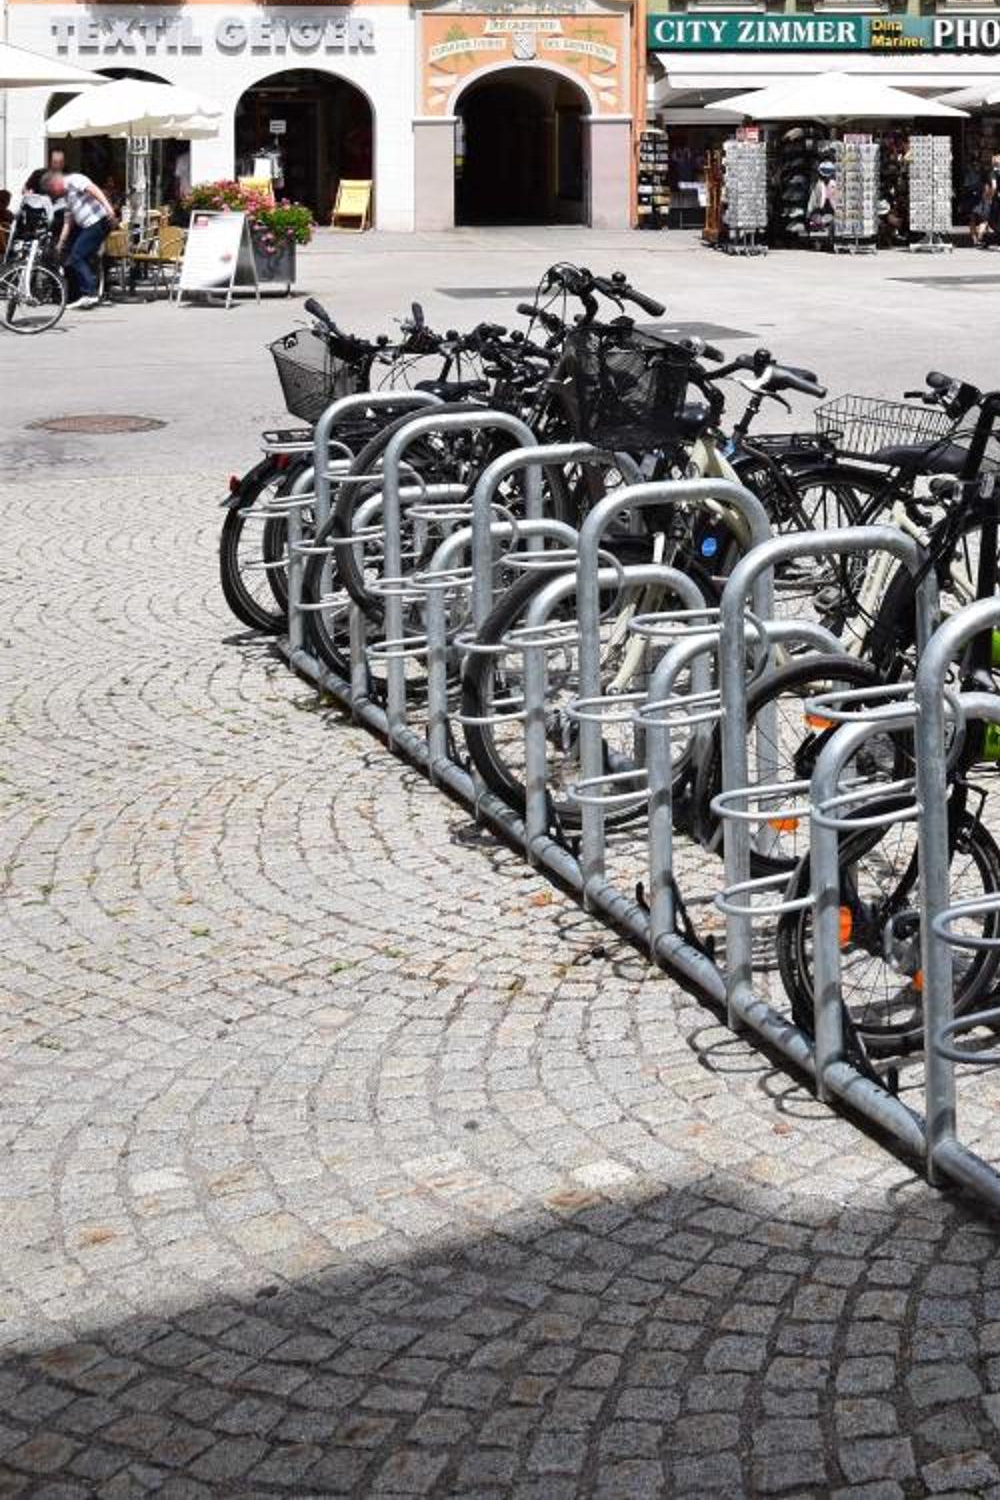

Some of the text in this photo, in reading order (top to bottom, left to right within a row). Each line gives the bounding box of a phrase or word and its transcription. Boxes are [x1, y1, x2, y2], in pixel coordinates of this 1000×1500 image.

[654, 20, 857, 44] CITY ZIMMER
[871, 19, 903, 31] Dina
[51, 16, 376, 55] TEXTIL GEIGER
[871, 35, 928, 47] Mariner
